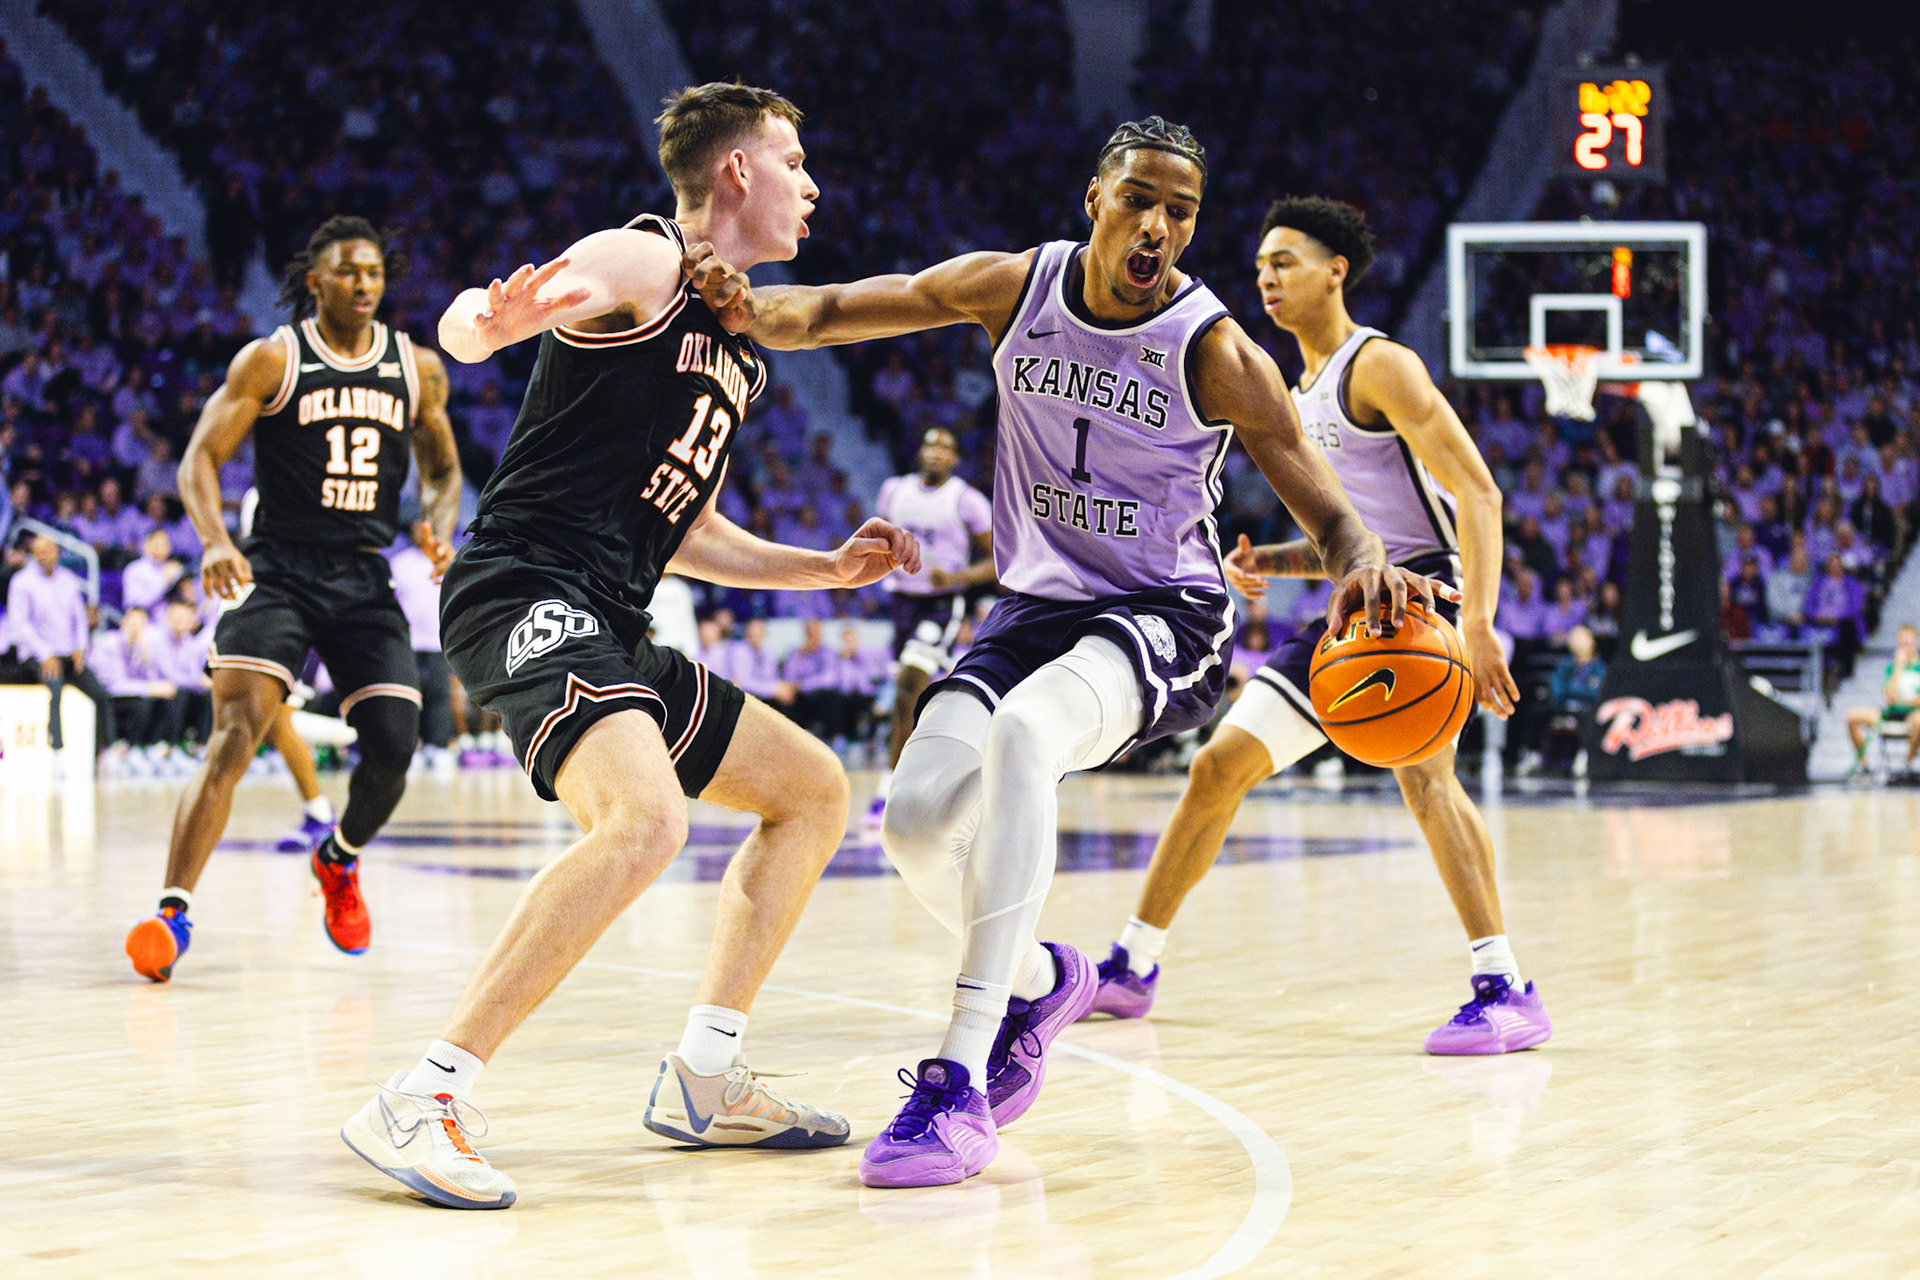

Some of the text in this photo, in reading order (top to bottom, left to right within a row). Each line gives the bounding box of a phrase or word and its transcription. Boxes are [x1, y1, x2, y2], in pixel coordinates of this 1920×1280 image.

[1573, 112, 1644, 170] 27
[298, 386, 404, 432] OKLAHOMA
[675, 332, 750, 425] OKLAHOM
[1012, 355, 1171, 430] KANSAS
[325, 424, 381, 477] 12
[667, 394, 732, 481] 13
[1071, 417, 1092, 484] 1
[320, 477, 379, 512] STATE
[1032, 483, 1140, 538] STATE
[508, 600, 597, 672] OSU
